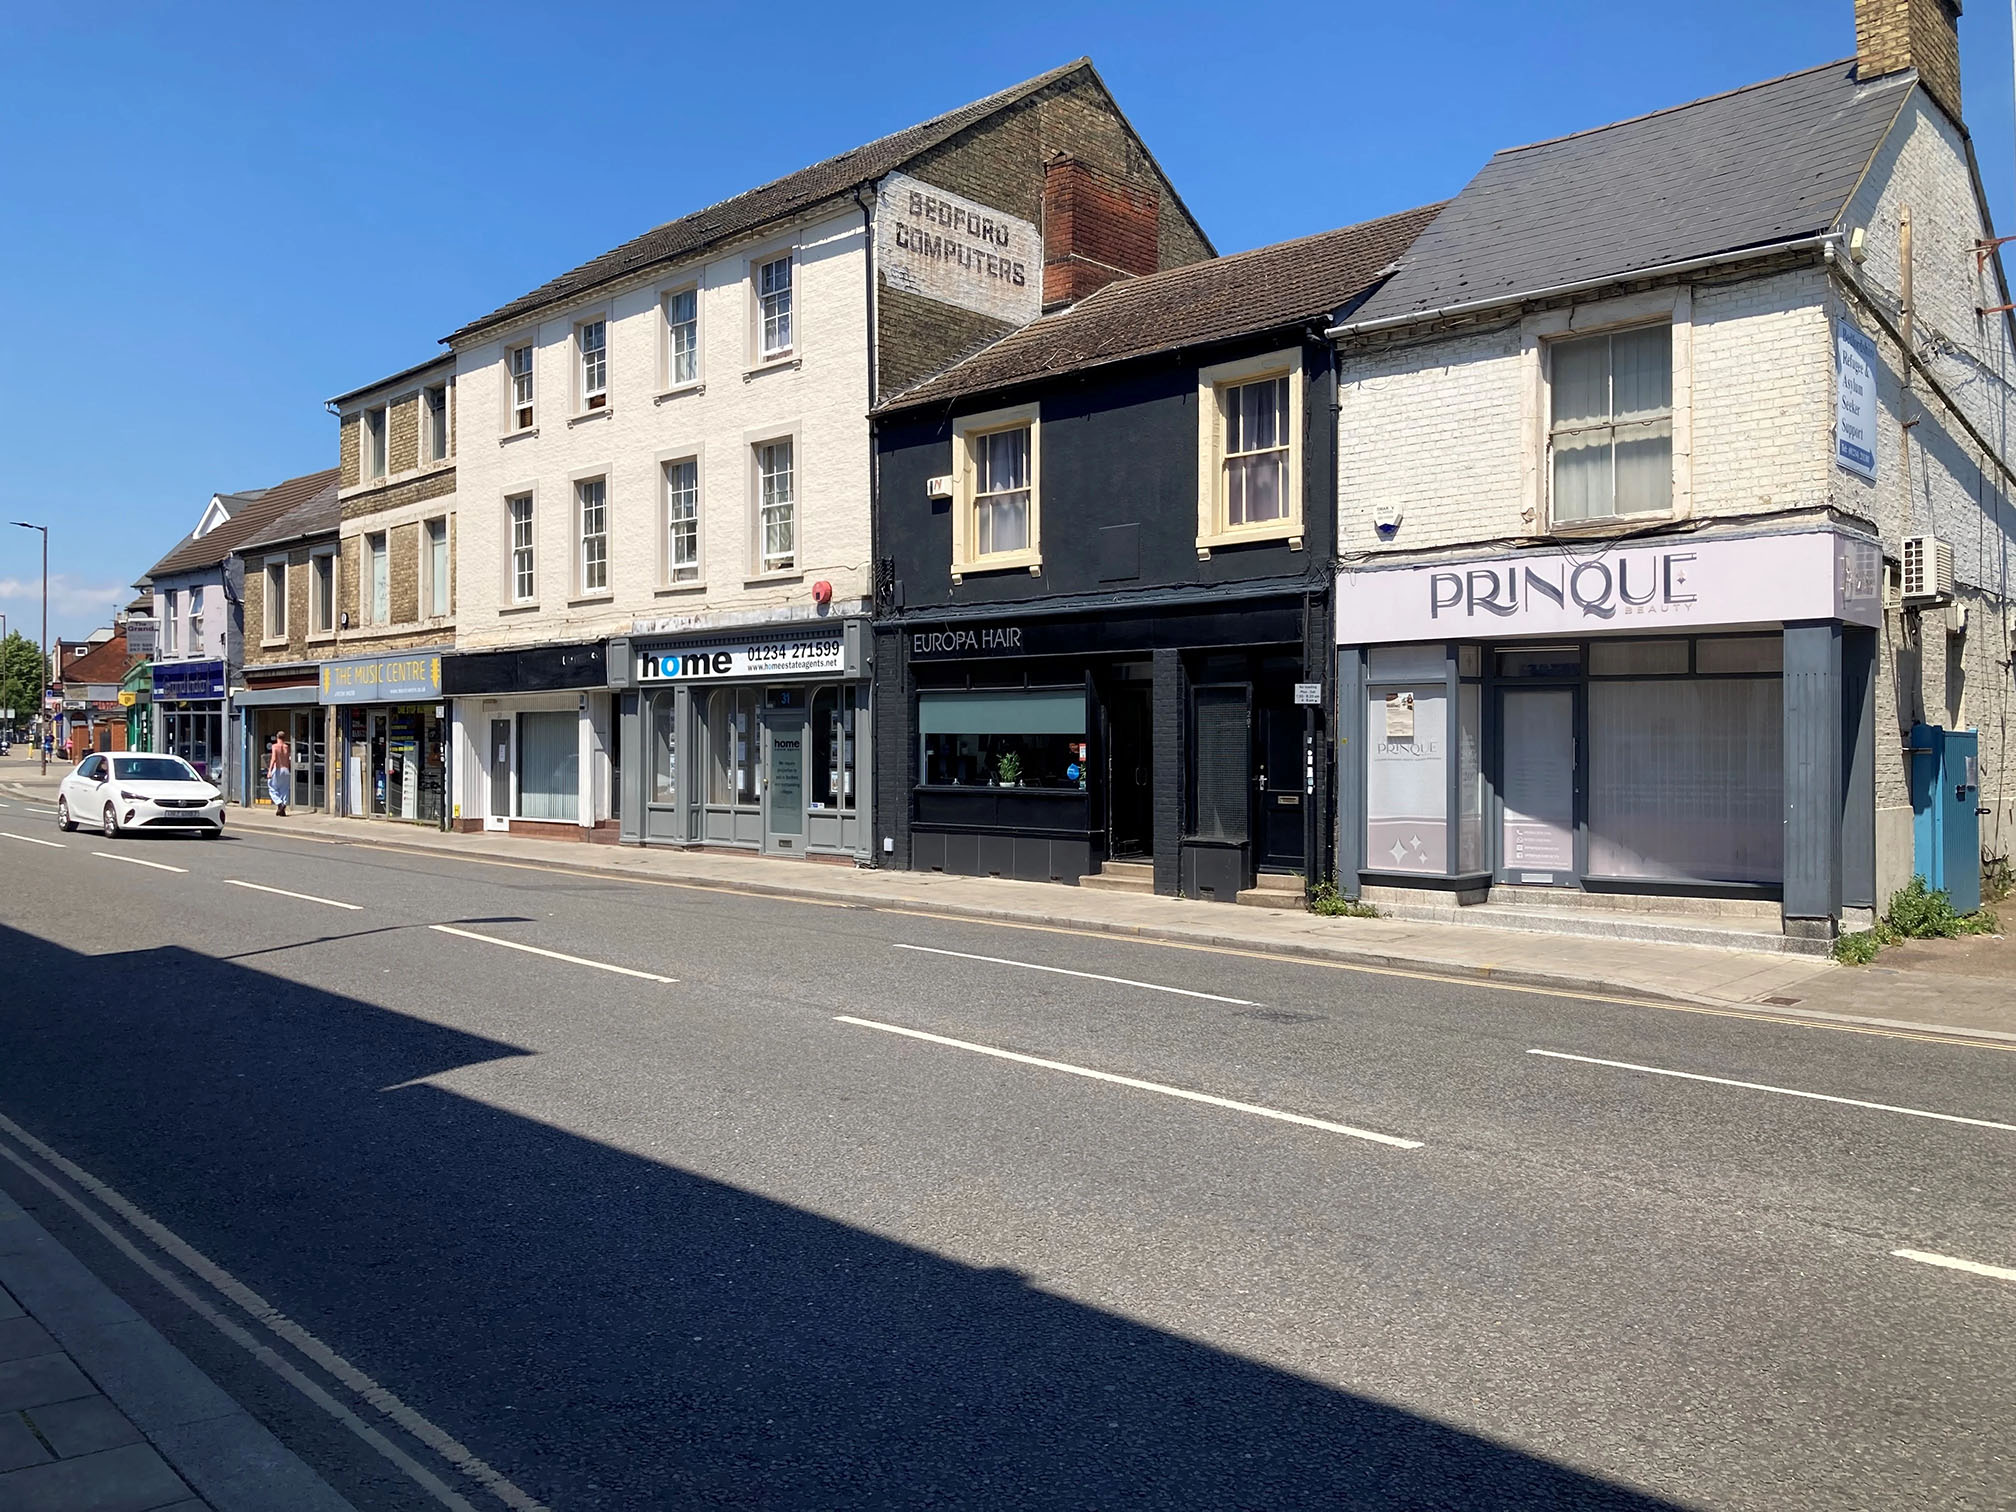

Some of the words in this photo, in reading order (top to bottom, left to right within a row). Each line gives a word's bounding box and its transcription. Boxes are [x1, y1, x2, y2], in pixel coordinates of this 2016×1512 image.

[909, 190, 1009, 248] BEDFORD
[896, 221, 1025, 287] COMPUTERS
[1842, 350, 1864, 376] Refugee
[1842, 375, 1864, 397] Asylum
[1841, 395, 1861, 417] Seeker
[1841, 417, 1864, 441] Support
[1430, 552, 1698, 620] PRINQUE
[1624, 602, 1695, 615] BEAUTY
[914, 630, 978, 653] EUROPA
[982, 627, 1022, 649] HAIR
[642, 650, 733, 678] home
[747, 644, 787, 662] 01234
[792, 640, 840, 659] 271599
[747, 658, 837, 672] www.homeestateagents.net
[334, 666, 353, 686] THE
[354, 663, 384, 685] MUSIC
[386, 660, 427, 683] CENTRE
[781, 692, 791, 704] 31
[774, 739, 800, 748] home
[1377, 742, 1438, 756] PRINQUE
